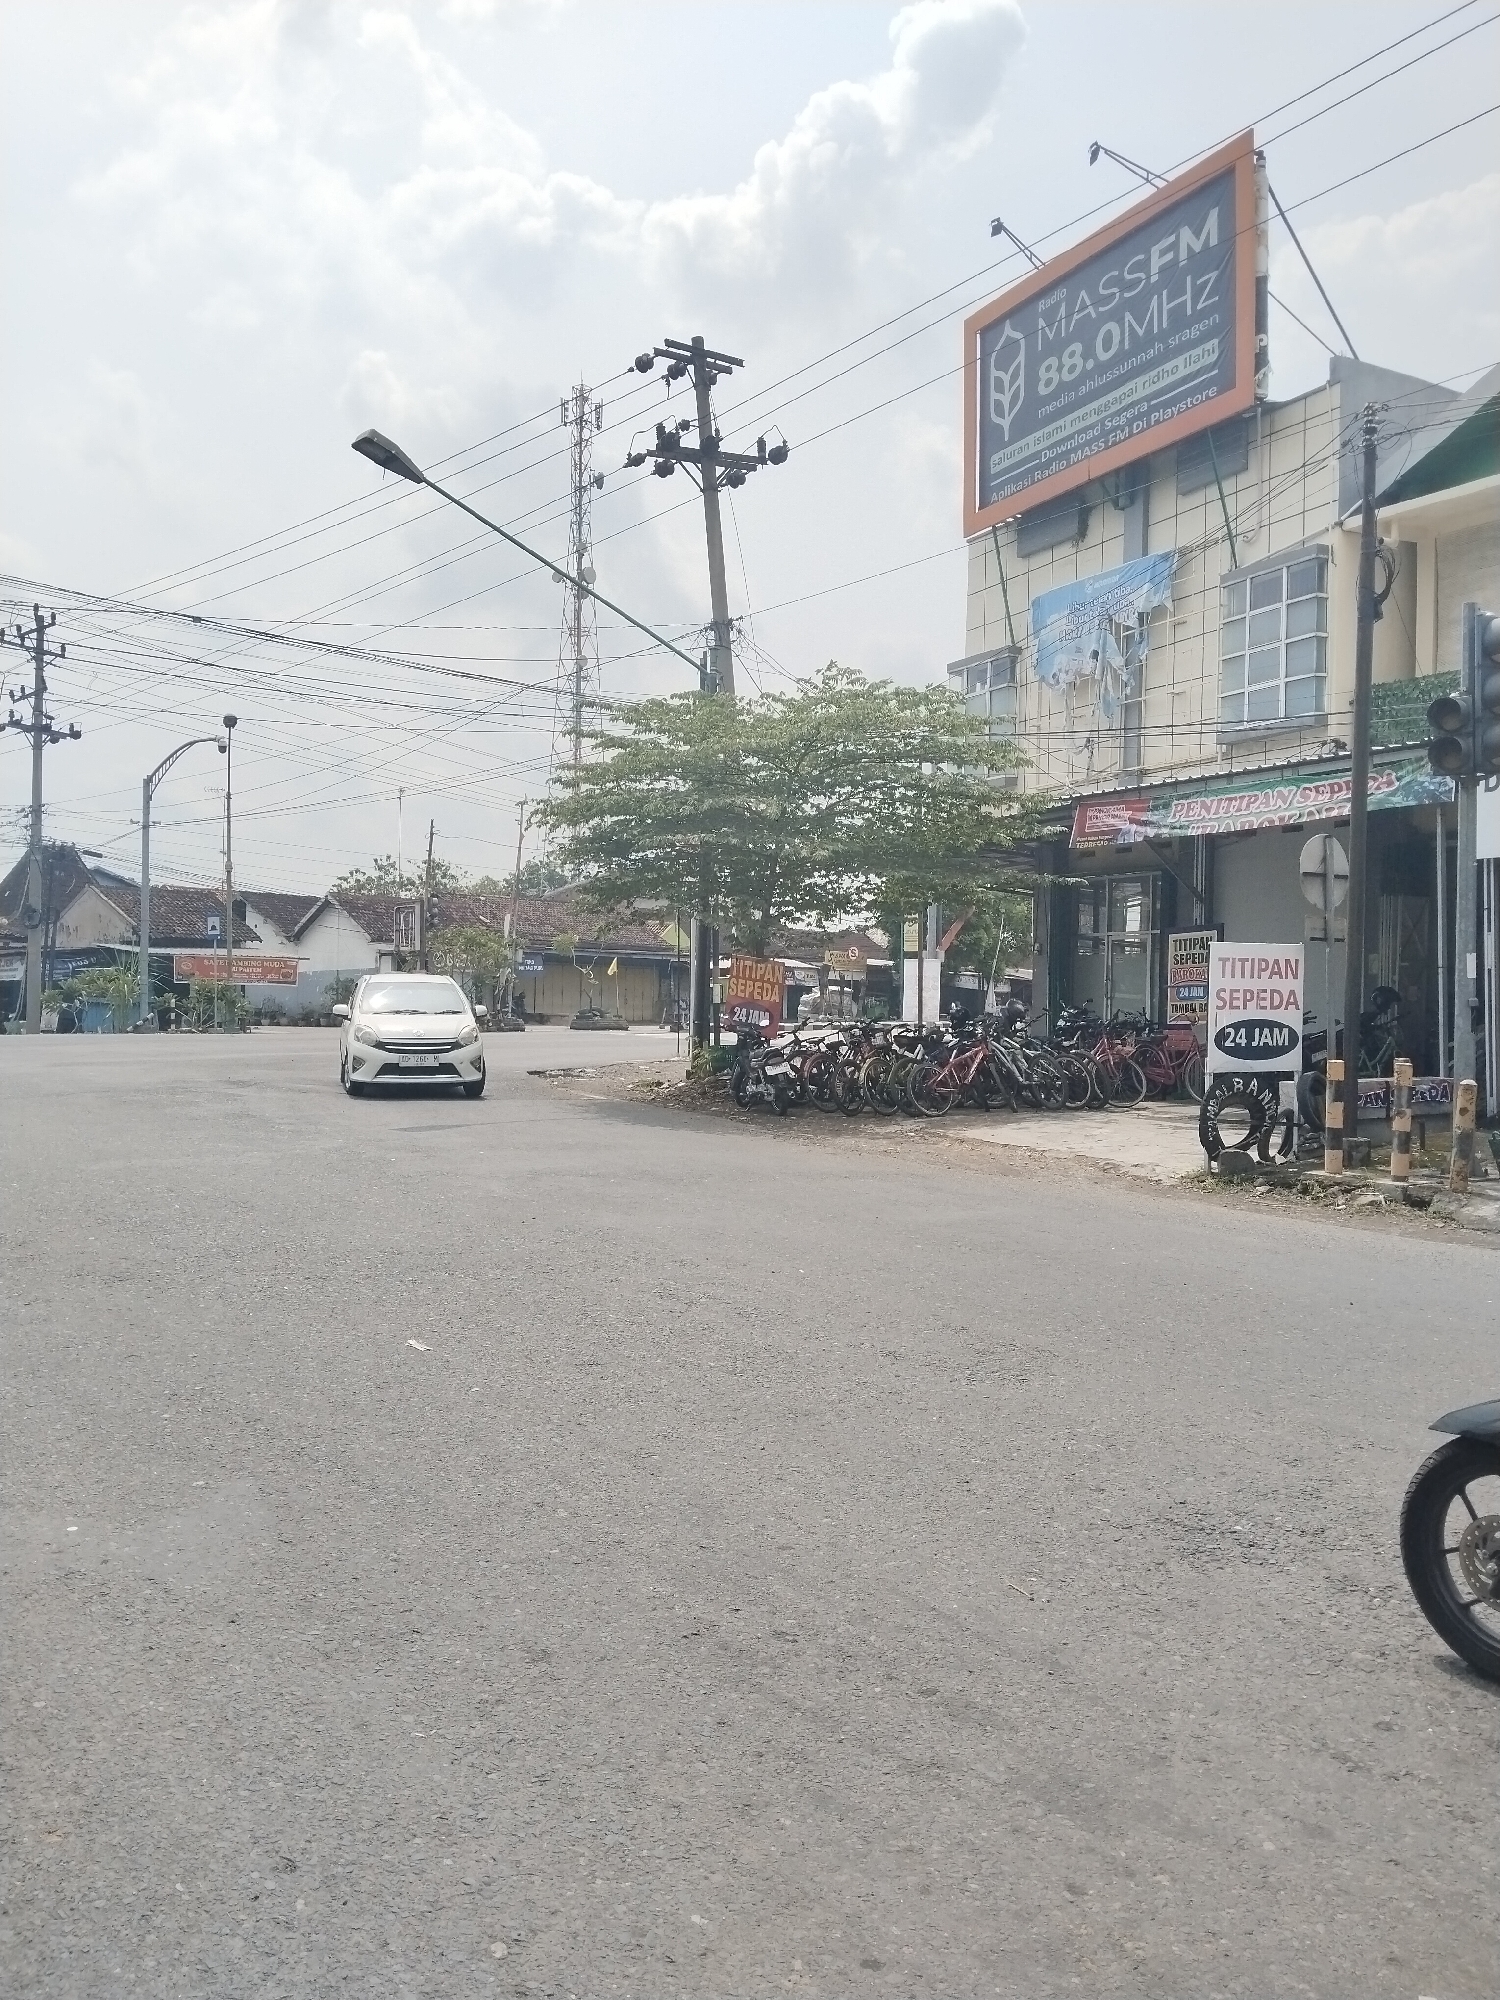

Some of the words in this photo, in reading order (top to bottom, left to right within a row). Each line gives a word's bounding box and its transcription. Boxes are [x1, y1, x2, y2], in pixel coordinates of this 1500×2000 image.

[1038, 288, 1067, 313] Radio
[1038, 391, 1075, 418] media
[1078, 342, 1163, 396] ahlussunnah
[1168, 314, 1219, 349] sragen
[992, 443, 1030, 469] saluran
[1033, 420, 1066, 447] islami
[1070, 381, 1138, 428] menggapai
[1142, 364, 1179, 390] ridho
[1041, 422, 1101, 462] Download
[1104, 401, 1148, 430] Segera
[990, 475, 1032, 504] Aplikasi
[1034, 460, 1067, 482] Radio
[1070, 438, 1105, 465] MASS
[1108, 426, 1129, 446] FM
[1133, 417, 1147, 434] Di
[1151, 386, 1217, 426] Playstore
[1169, 786, 1298, 823] PENITIPAN
[264, 960, 285, 968] MUDA
[731, 958, 784, 984] TITIPAN
[1171, 967, 1208, 985] BAROKA
[1218, 957, 1300, 979] TITIPAN
[728, 977, 780, 1003] SEPEDA
[1180, 987, 1189, 997] 24
[1215, 988, 1300, 1011] SEPEDA
[733, 1006, 747, 1022] 24
[748, 1008, 770, 1026] JAM
[1198, 1002, 1208, 1013] BA
[1224, 1027, 1247, 1047] 24
[1251, 1027, 1289, 1047] JAM
